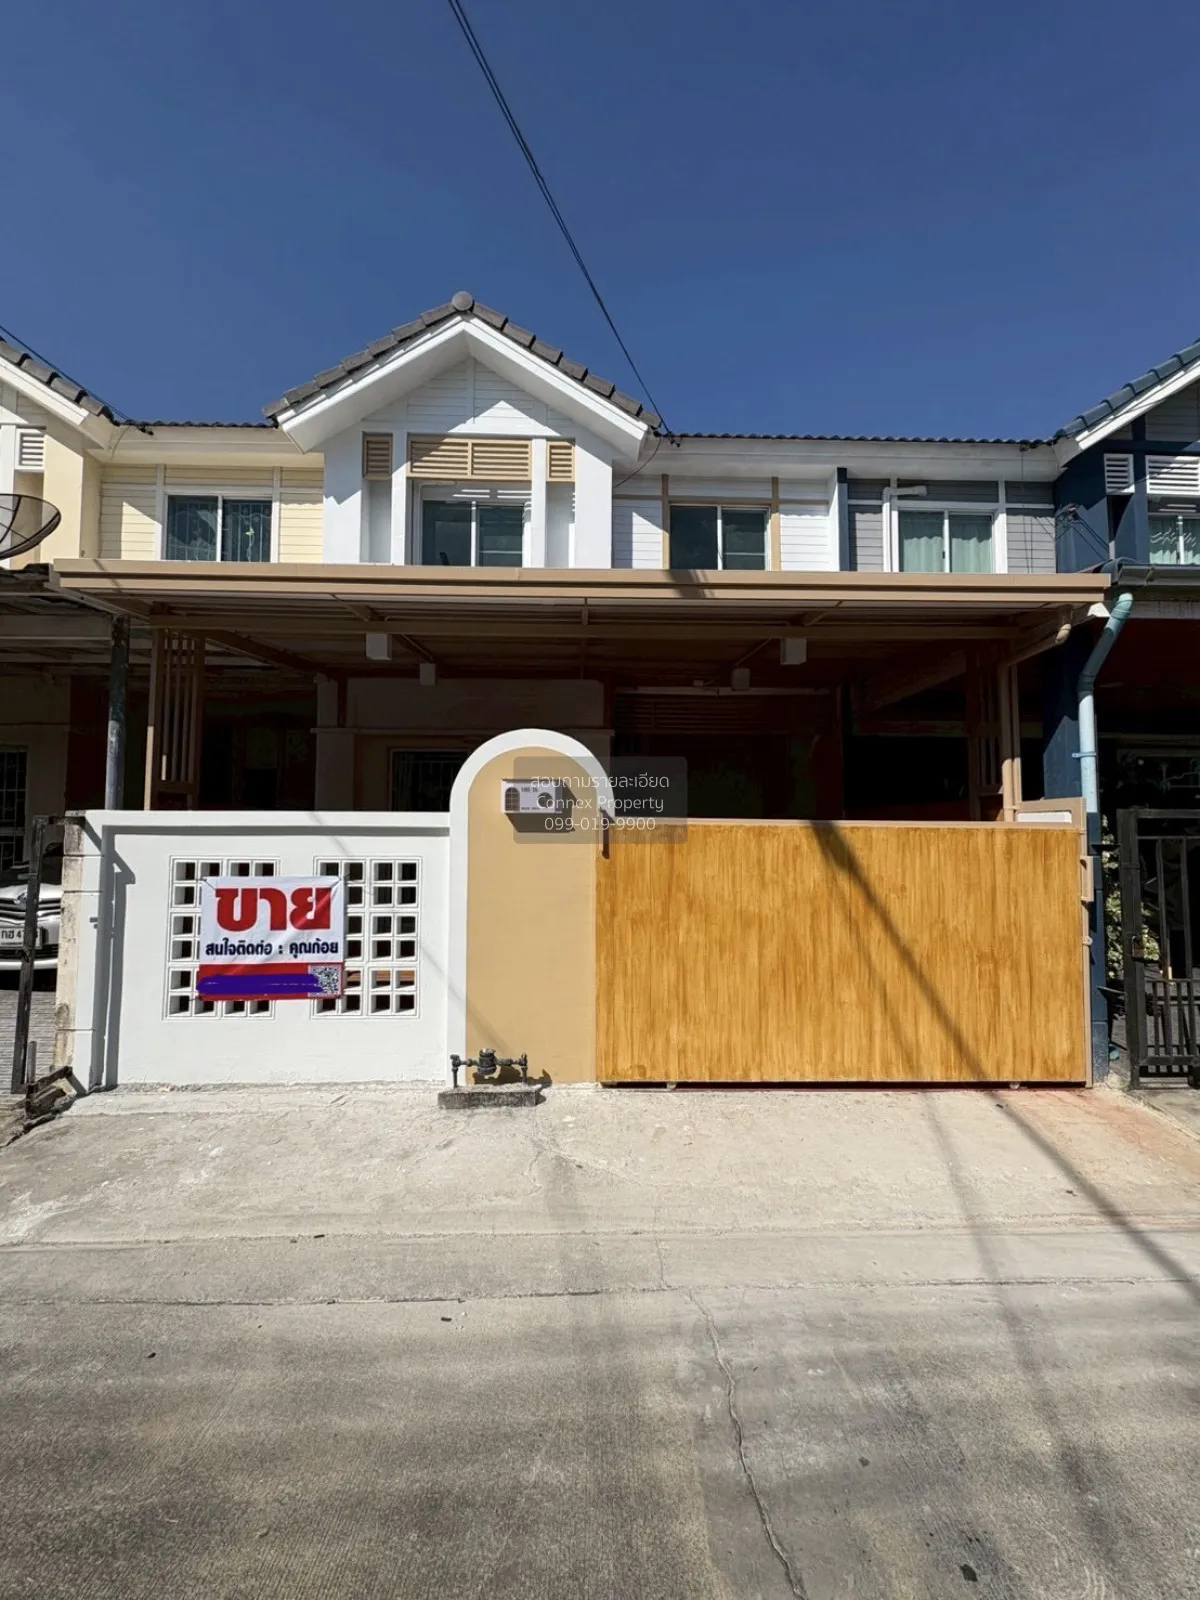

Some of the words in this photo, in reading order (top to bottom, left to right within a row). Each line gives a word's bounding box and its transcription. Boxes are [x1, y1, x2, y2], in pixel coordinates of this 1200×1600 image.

[215, 887, 332, 932] ขาย
[205, 938, 272, 956] สนใจติดต่อ
[289, 939, 338, 959] คุณก้อย
